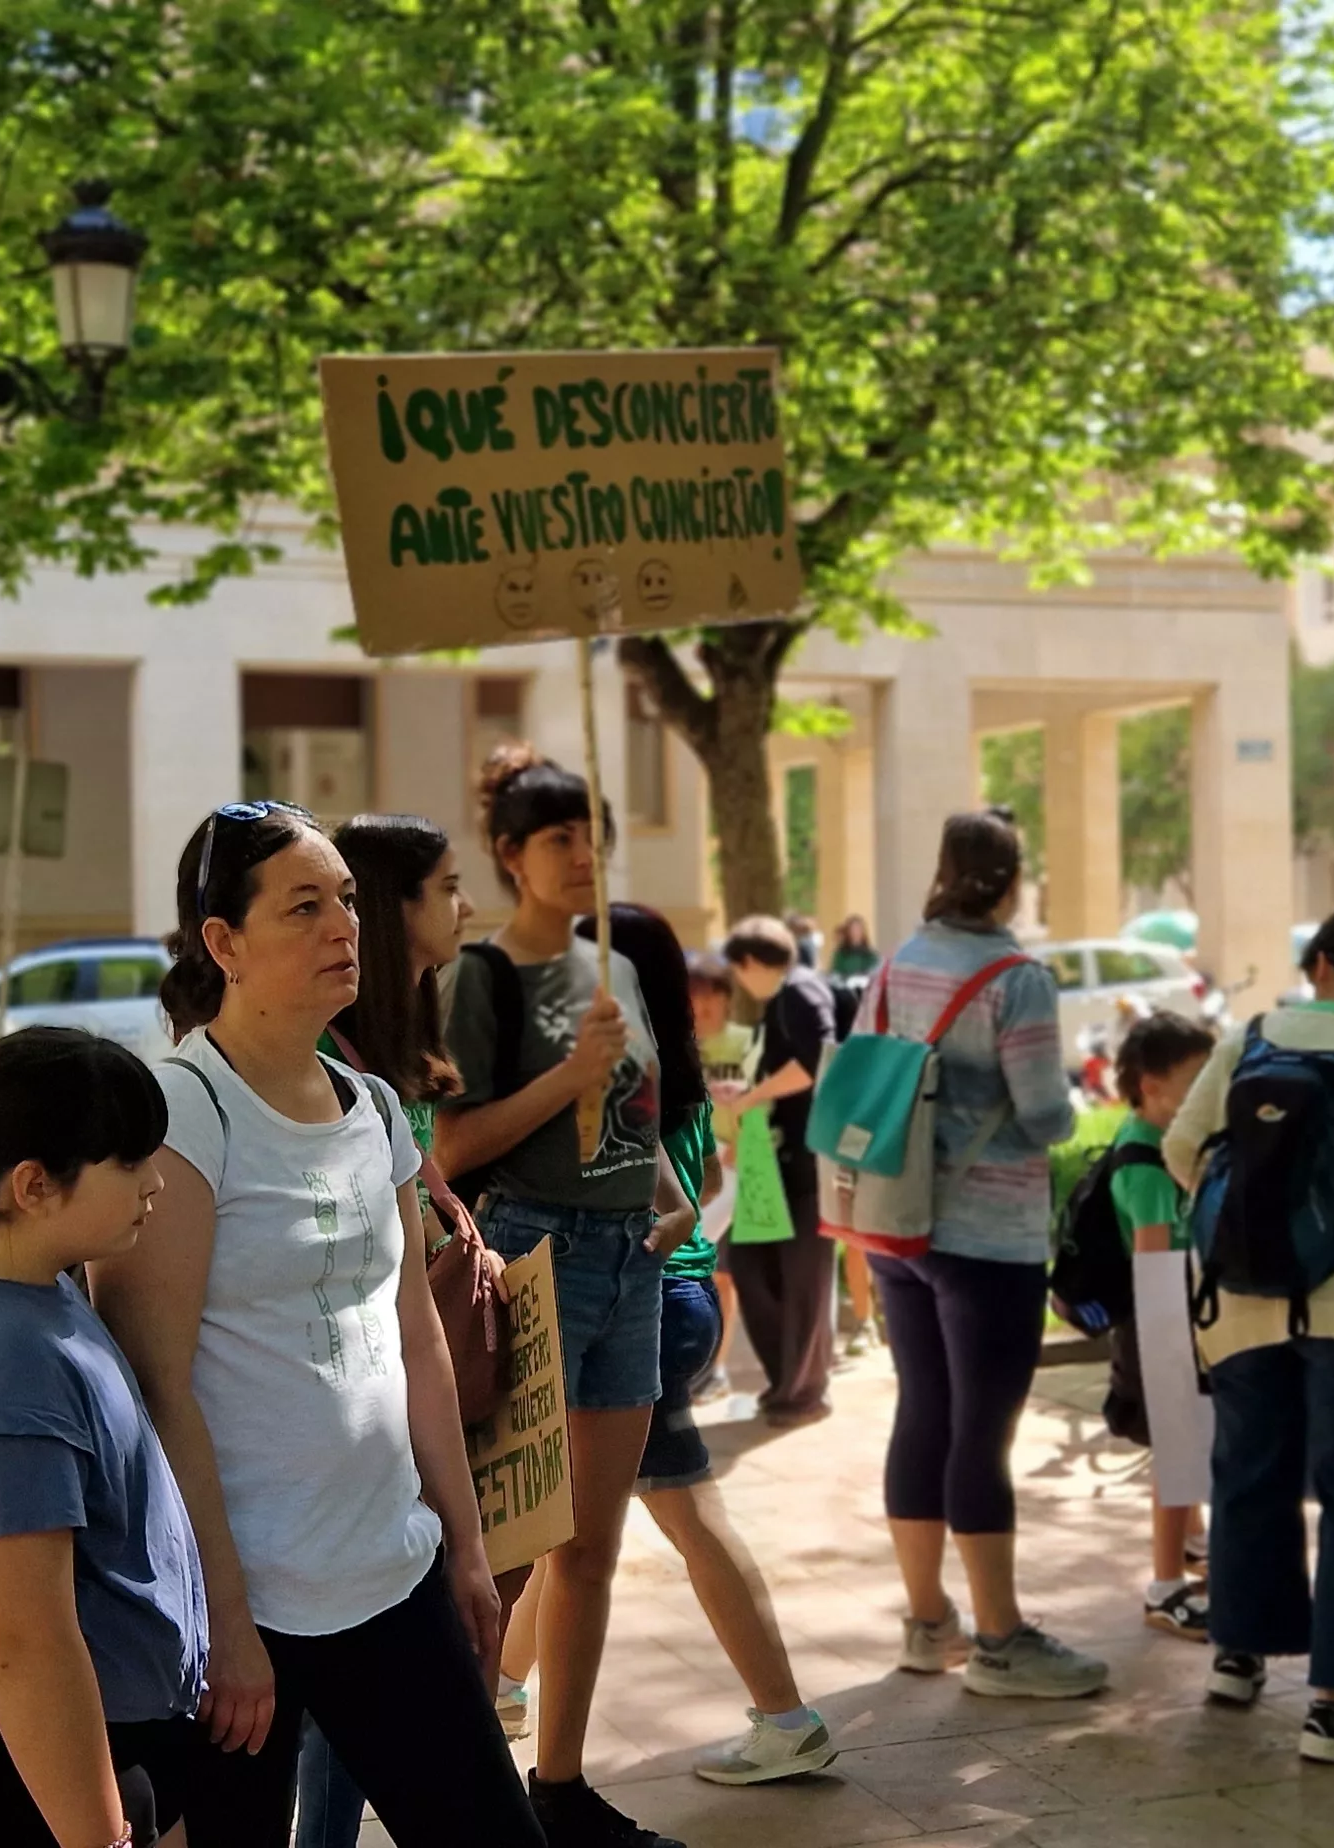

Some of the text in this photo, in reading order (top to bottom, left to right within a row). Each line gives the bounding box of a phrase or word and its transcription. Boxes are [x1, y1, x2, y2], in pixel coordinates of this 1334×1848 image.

[377, 366, 515, 463] ¡QUÉ
[390, 487, 490, 567] ANTE
[491, 470, 626, 554] VUESTRO
[471, 1426, 564, 1534] ESTUDIAR
